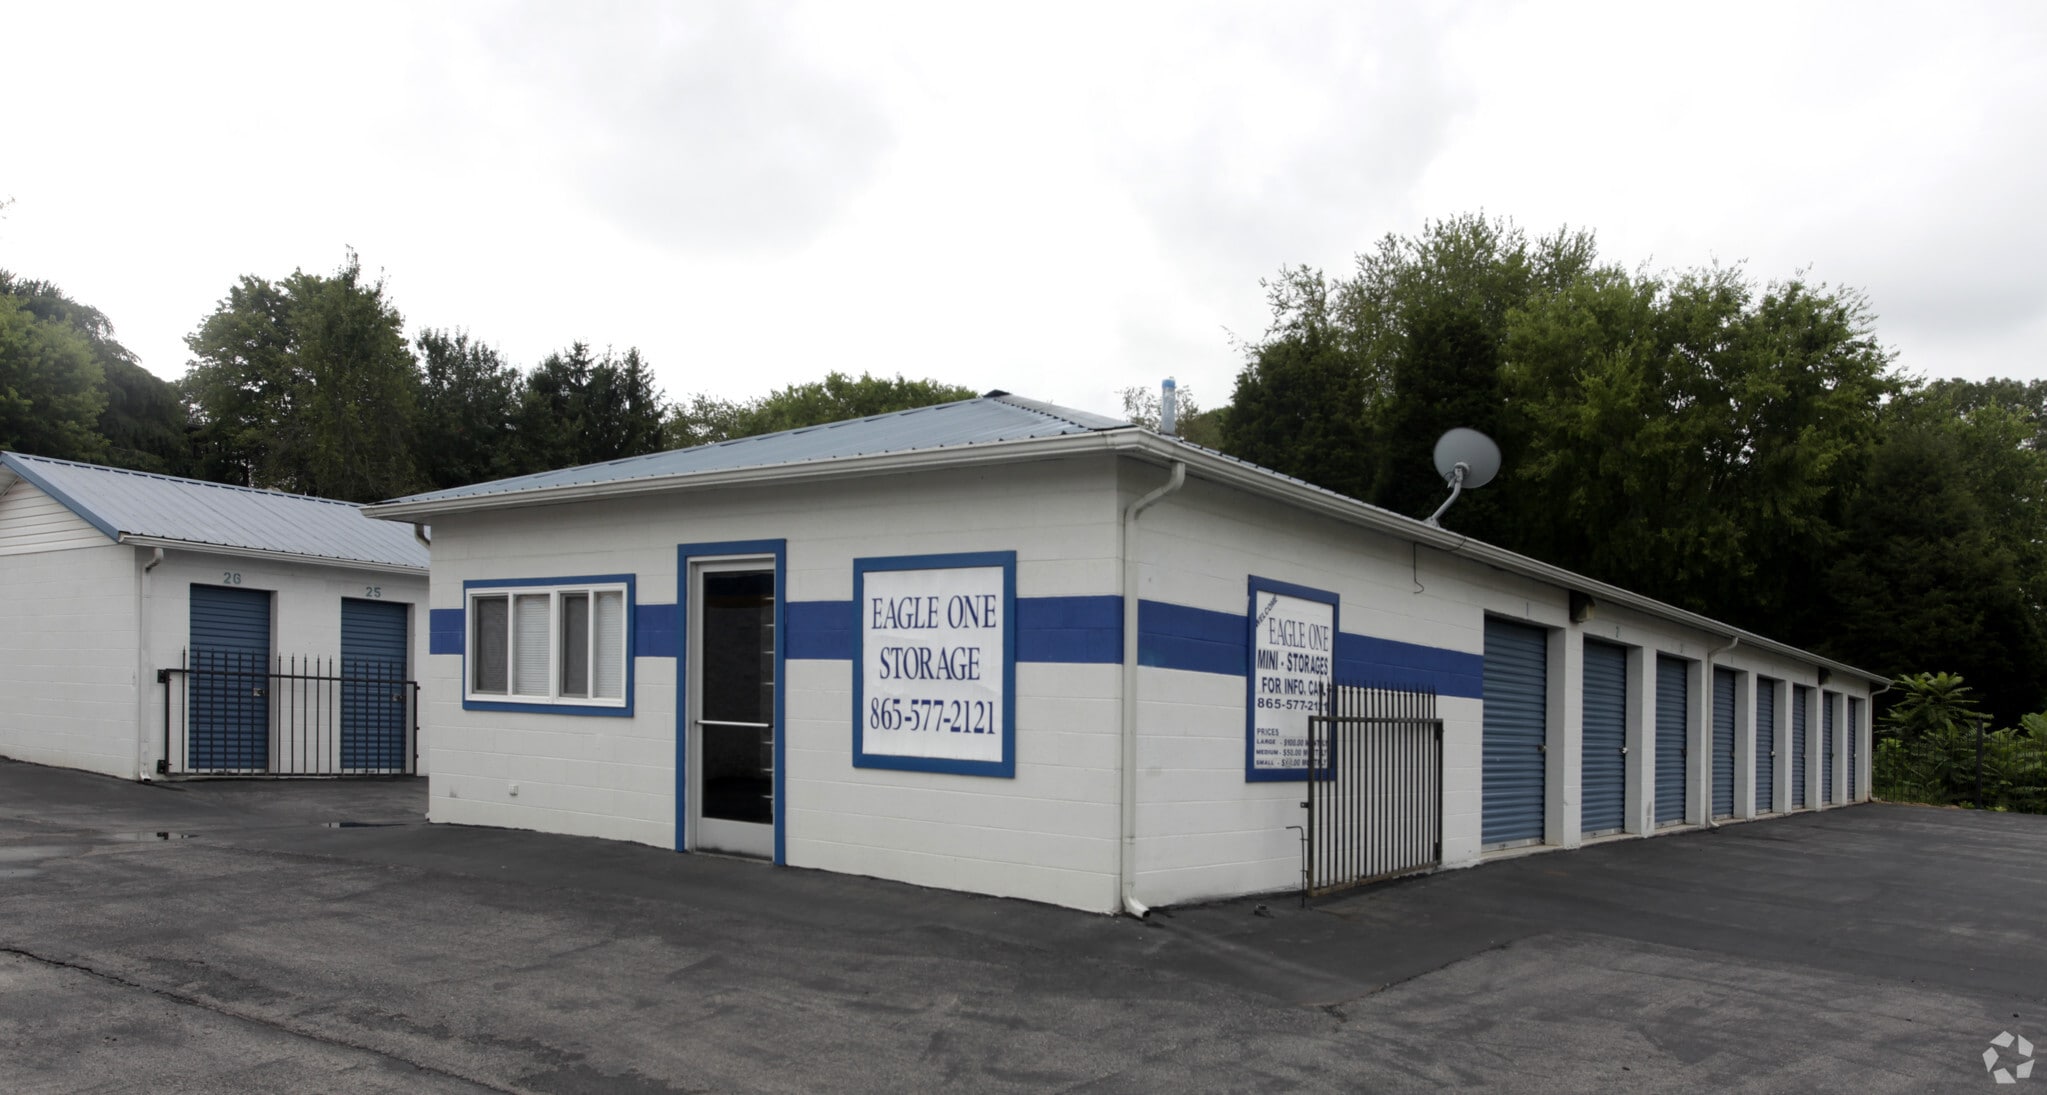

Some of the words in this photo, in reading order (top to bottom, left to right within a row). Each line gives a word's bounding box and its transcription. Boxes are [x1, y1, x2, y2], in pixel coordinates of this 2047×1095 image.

[223, 571, 242, 585] 26
[365, 586, 382, 598] 25
[871, 596, 939, 630] EAGLE
[947, 594, 997, 629] ONE
[1268, 617, 1306, 649] EAGLE
[1308, 623, 1329, 652] ONE
[879, 646, 981, 681] STORAGE
[1257, 649, 1279, 671] MINI
[1287, 652, 1329, 676] STORAGES
[1262, 676, 1282, 694] FOR
[1308, 680, 1327, 697] CAL
[870, 697, 997, 735] 865-577-2121
[1257, 697, 1329, 712] 865-577-211
[1256, 727, 1280, 737] PRICES
